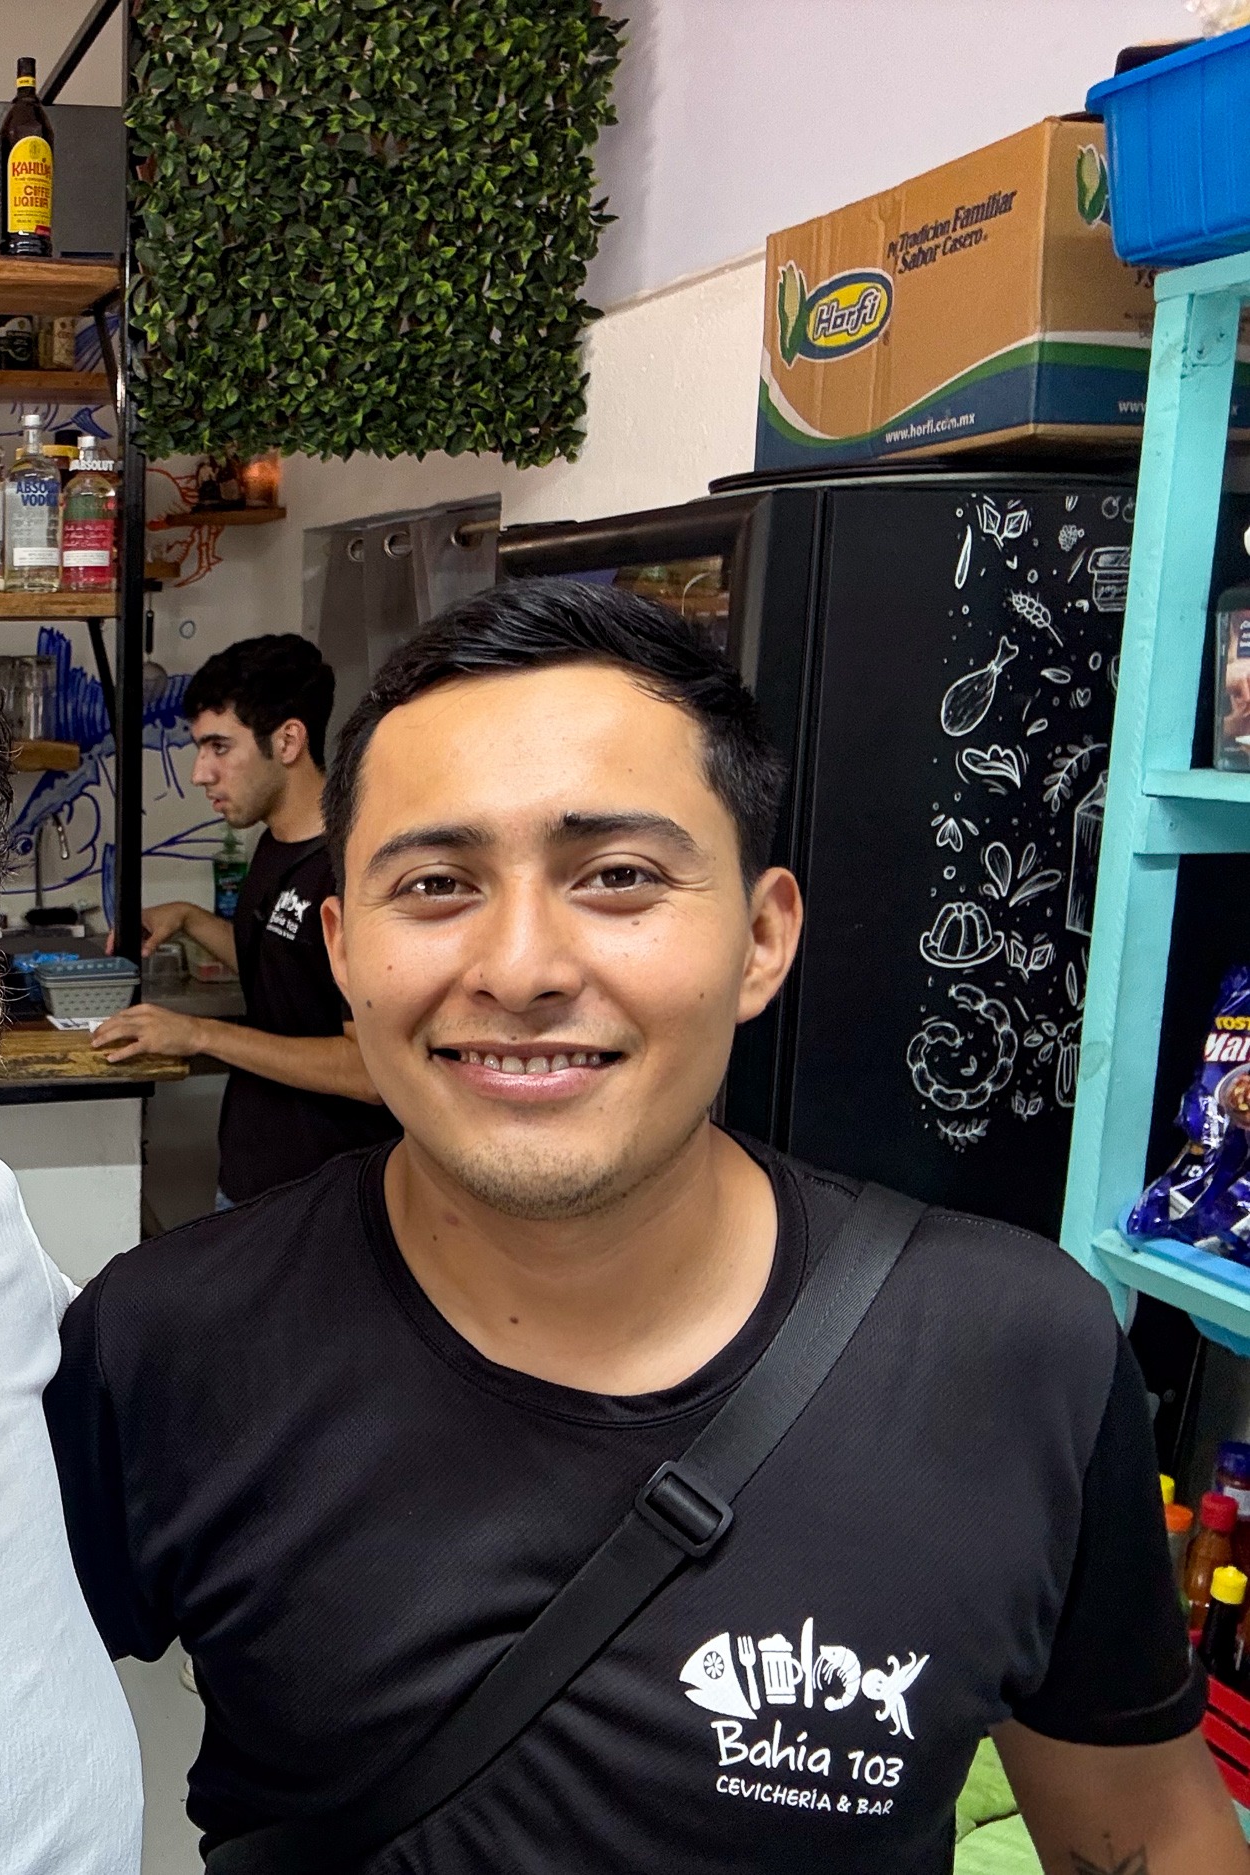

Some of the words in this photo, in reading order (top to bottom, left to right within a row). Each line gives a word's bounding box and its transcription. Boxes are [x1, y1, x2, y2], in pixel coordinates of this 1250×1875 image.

[951, 189, 1018, 232] Familiar
[898, 243, 941, 275] Sabor
[813, 286, 881, 341] Horfi
[885, 411, 975, 443] www.horfi.com.mx
[69, 460, 115, 471] ABSOLUT
[21, 494, 58, 507] VOD
[710, 1719, 831, 1777] Bahía
[848, 1750, 904, 1788] 103
[837, 1795, 851, 1813] &
[855, 1798, 894, 1815] BAR
